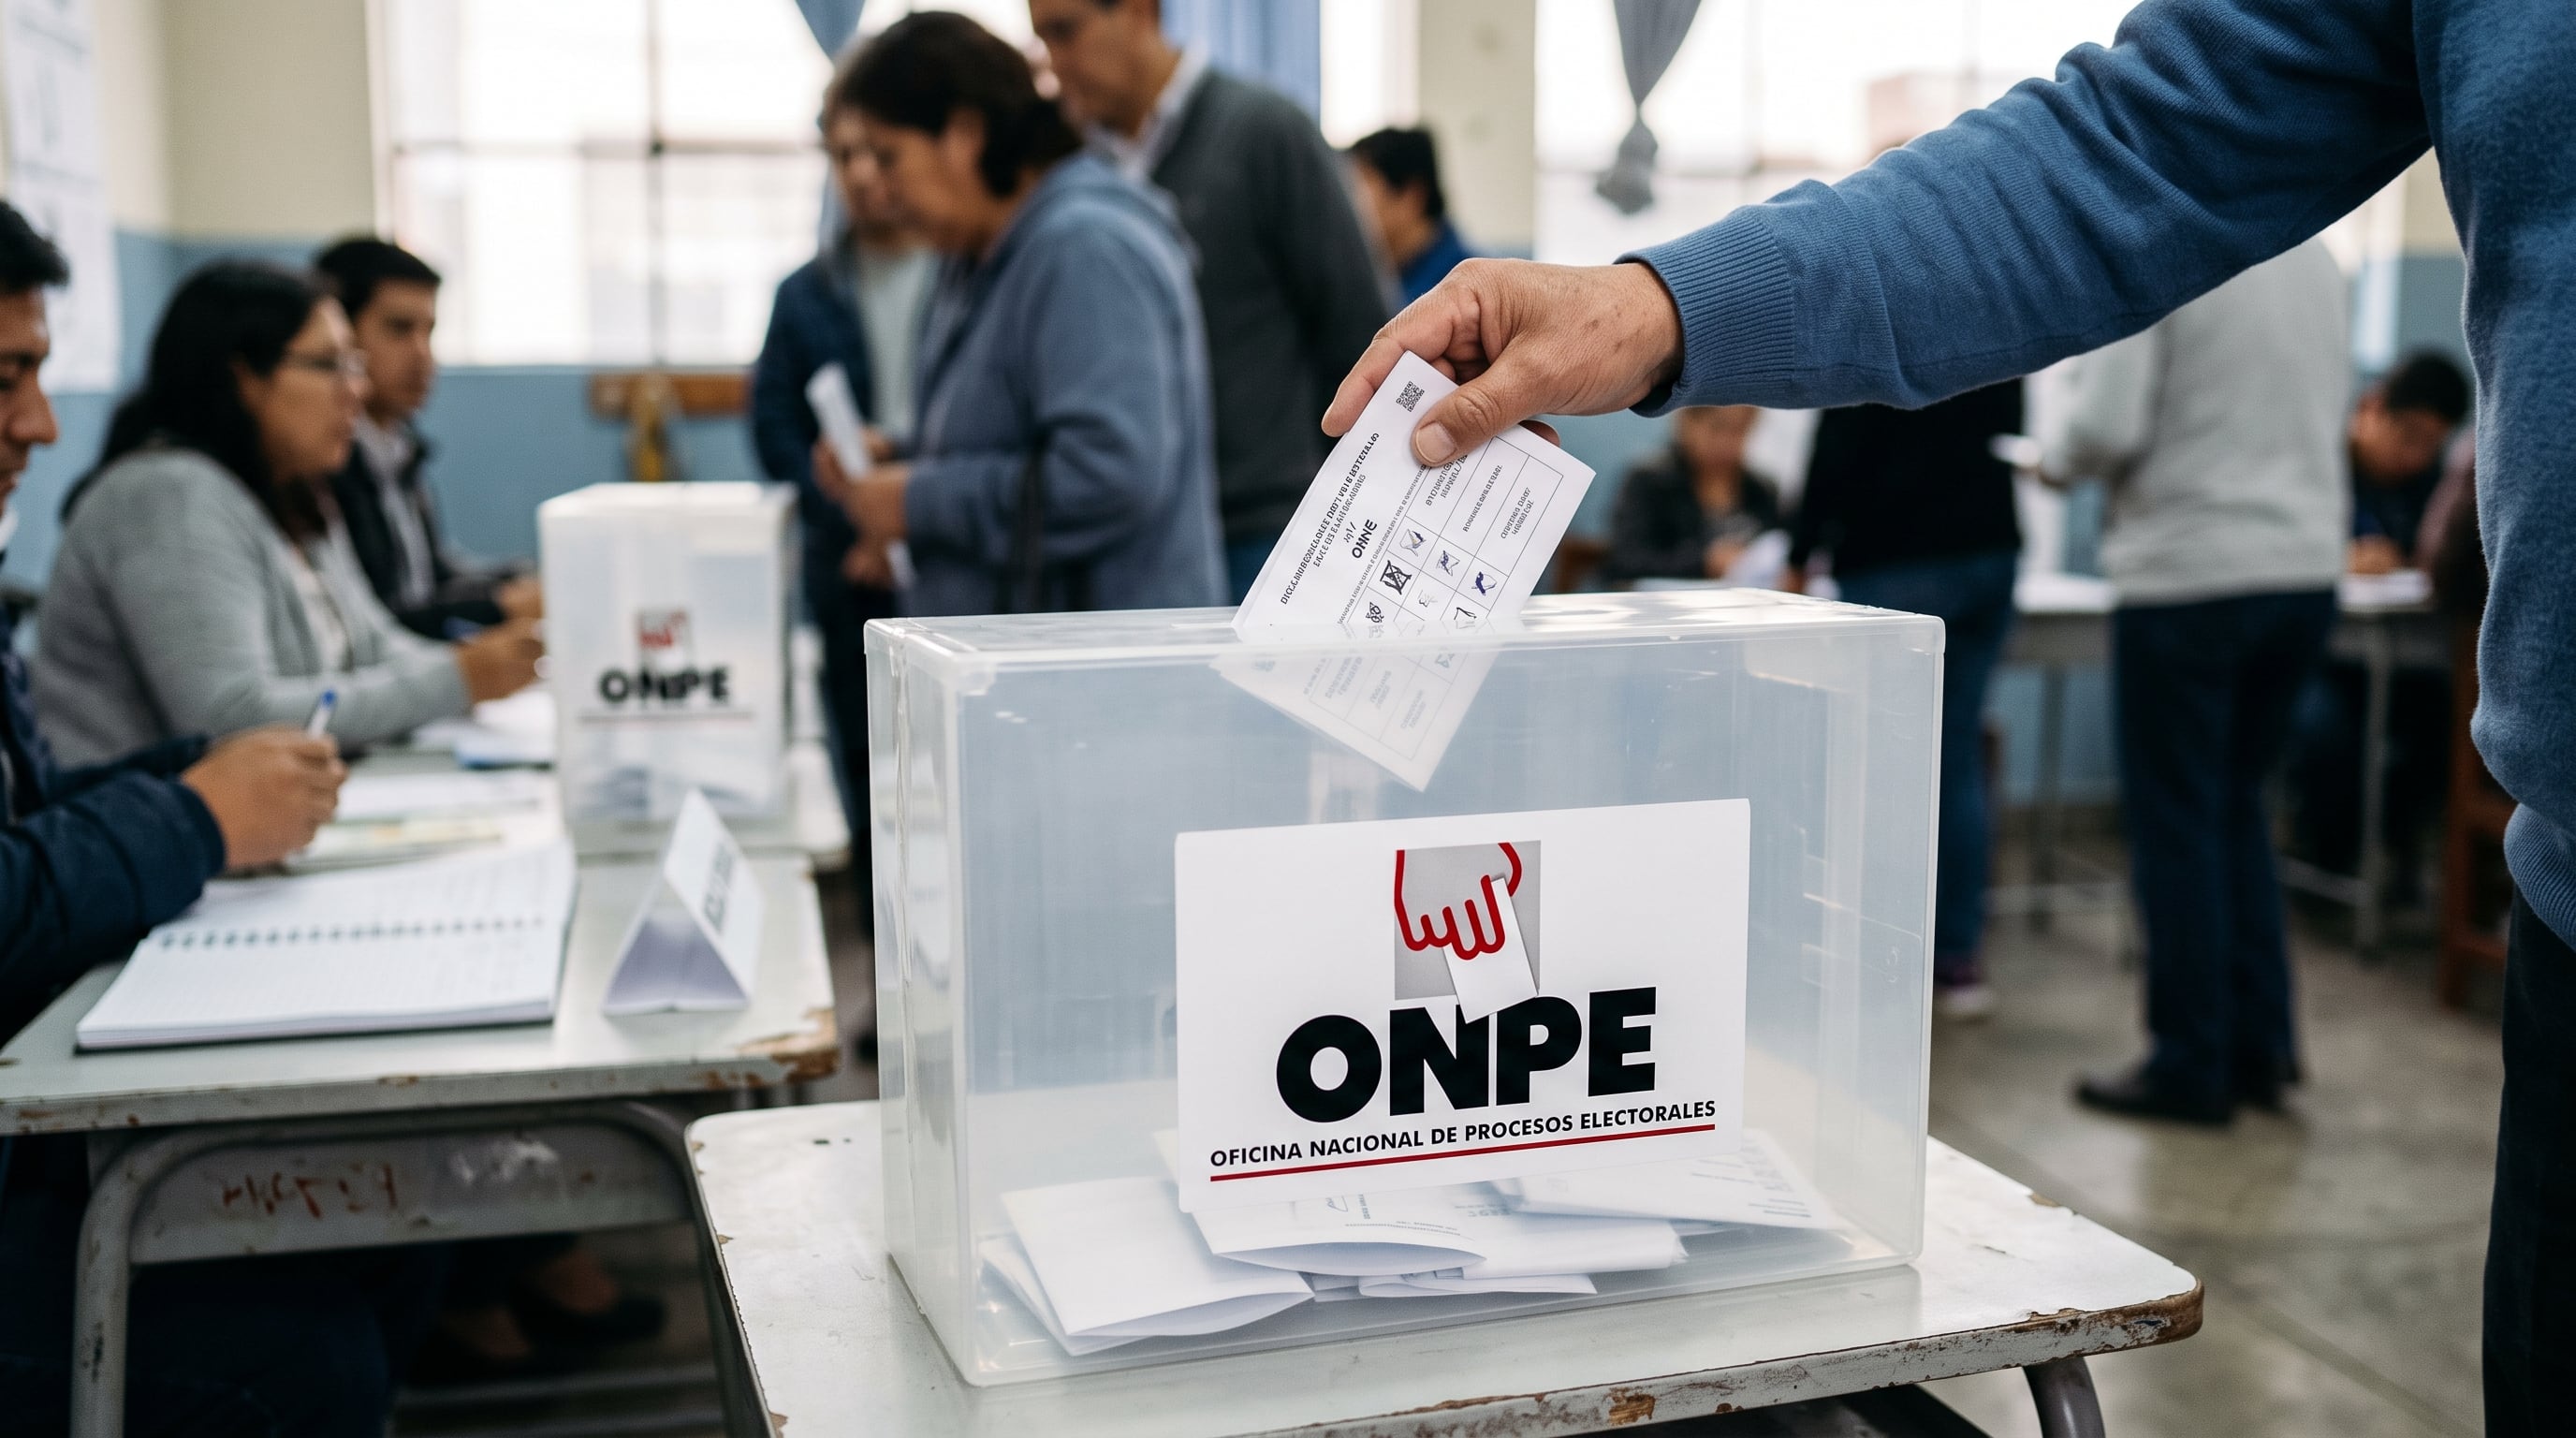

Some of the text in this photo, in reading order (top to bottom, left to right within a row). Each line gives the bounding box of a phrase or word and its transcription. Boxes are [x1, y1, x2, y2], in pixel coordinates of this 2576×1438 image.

[1277, 987, 1656, 1123] ONPE
[1210, 1100, 1716, 1167] OFICINA NACIONAL DE PROCESOS ELECTORALES
